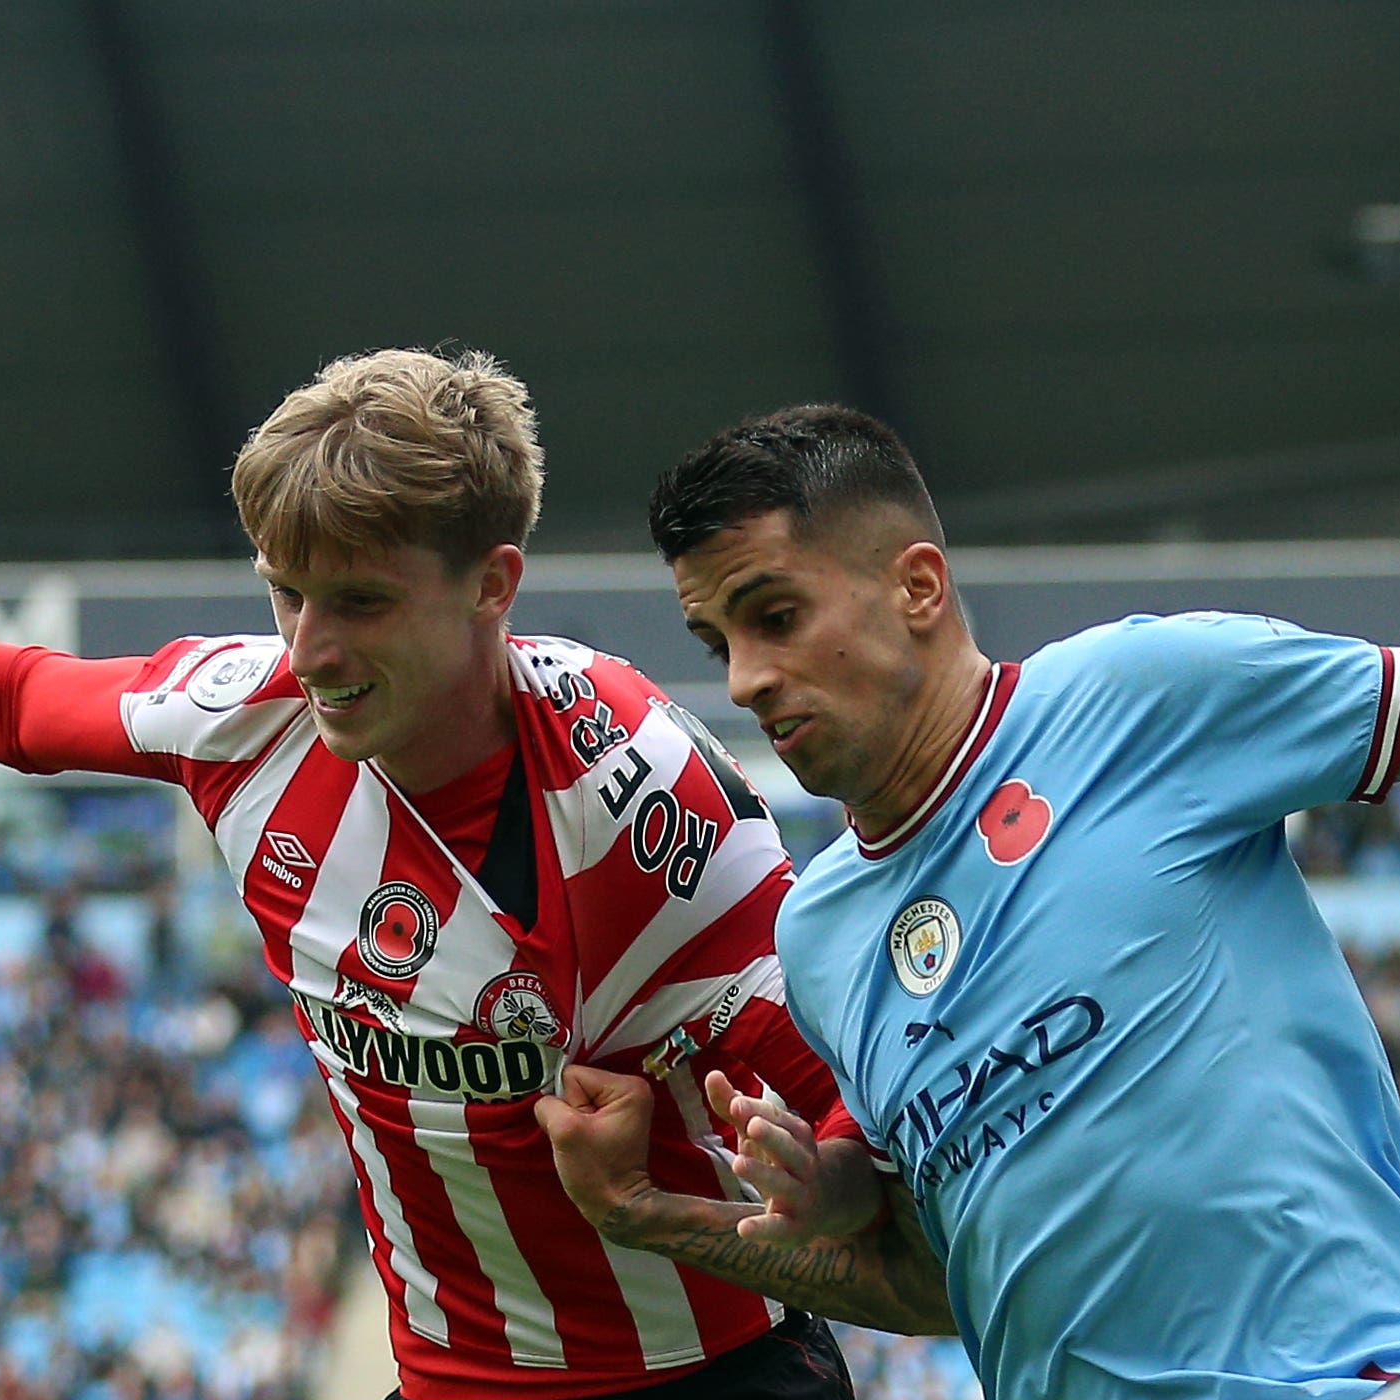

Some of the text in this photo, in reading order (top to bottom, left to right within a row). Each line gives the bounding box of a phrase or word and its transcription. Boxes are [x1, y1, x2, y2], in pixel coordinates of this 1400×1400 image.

[262, 854, 302, 889] umbro
[893, 903, 951, 991] MANCHESTER CITY
[708, 983, 741, 1036] lture
